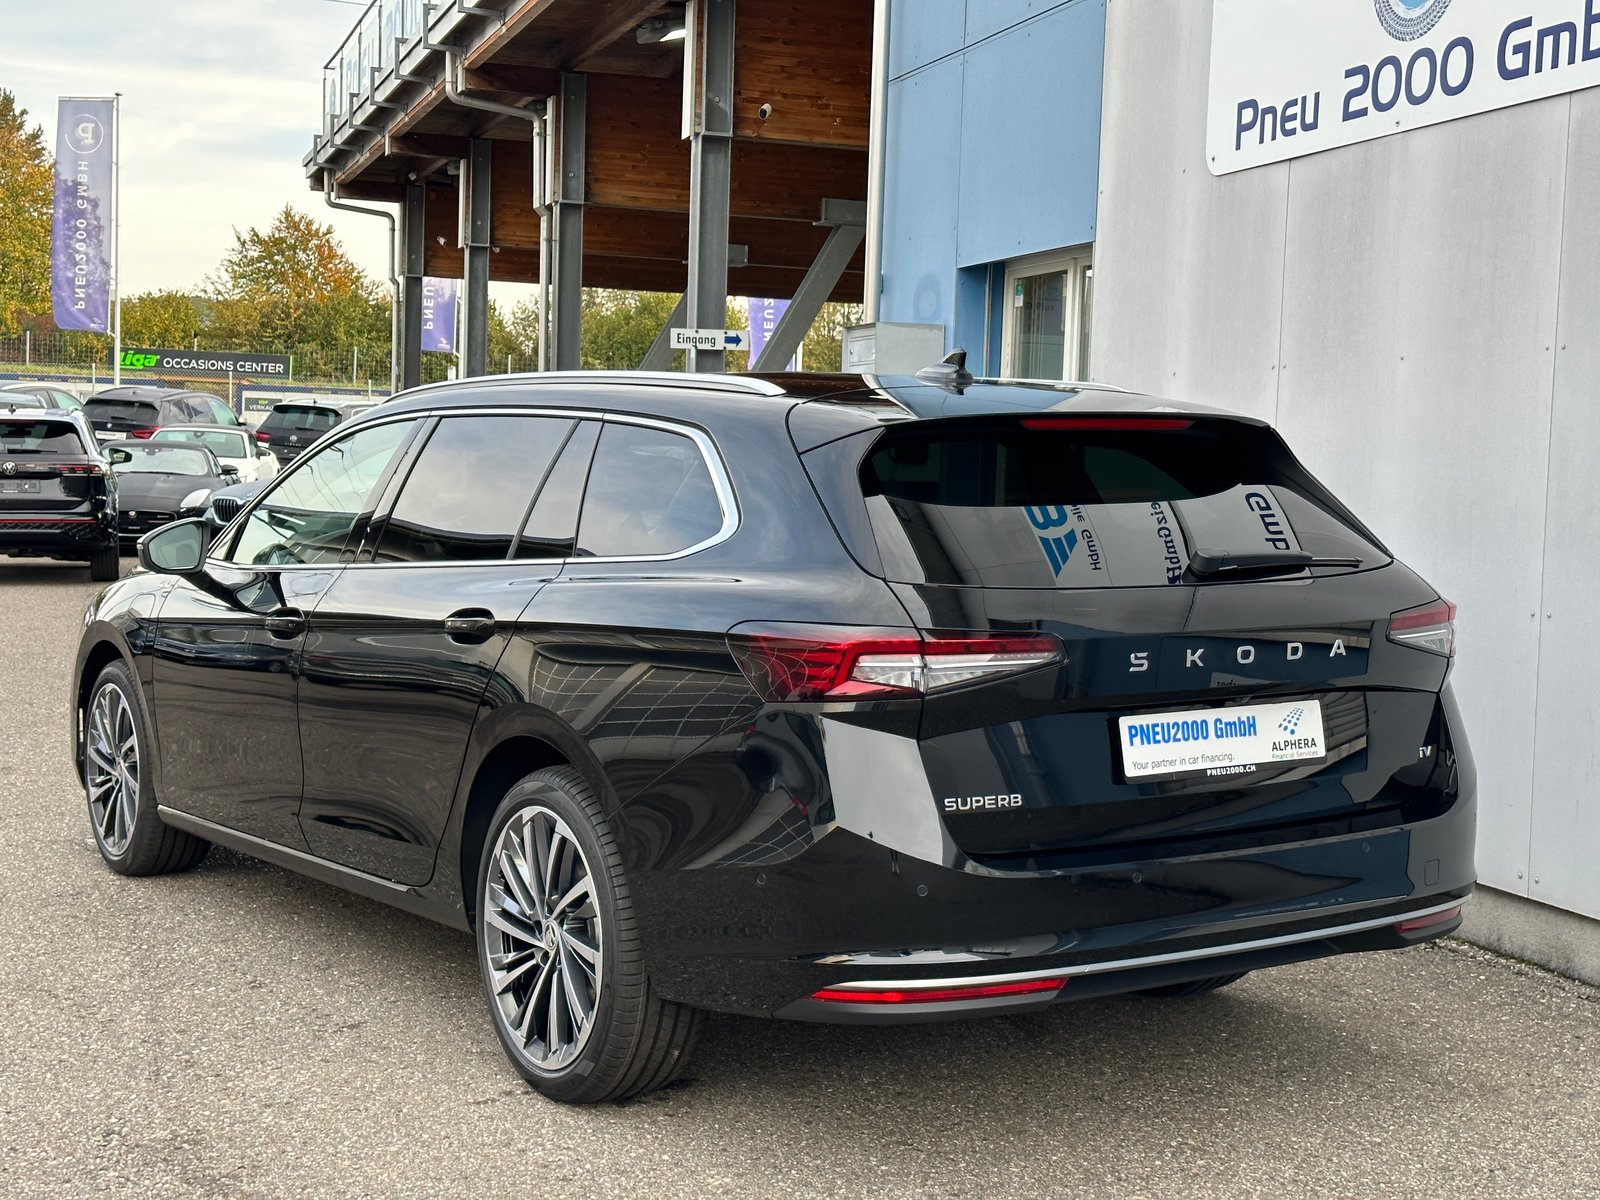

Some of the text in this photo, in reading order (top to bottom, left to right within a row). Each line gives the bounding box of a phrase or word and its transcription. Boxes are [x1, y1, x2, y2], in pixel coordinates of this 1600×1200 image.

[1235, 91, 1320, 151] Pneu
[1342, 36, 1474, 122] 2000
[676, 333, 716, 347] Eingang
[163, 357, 234, 371] OCCASIONS
[236, 361, 284, 374] CENTER
[1129, 639, 1347, 672] SKODA
[1128, 715, 1257, 746] PNEU2000 GmbH
[1271, 737, 1317, 752] ALPHERA
[1132, 753, 1236, 770] Your partner in car financing.
[1271, 750, 1318, 760] Financial Services
[1206, 764, 1256, 777] PNEU2000.CH
[944, 793, 1023, 811] SUPERB
